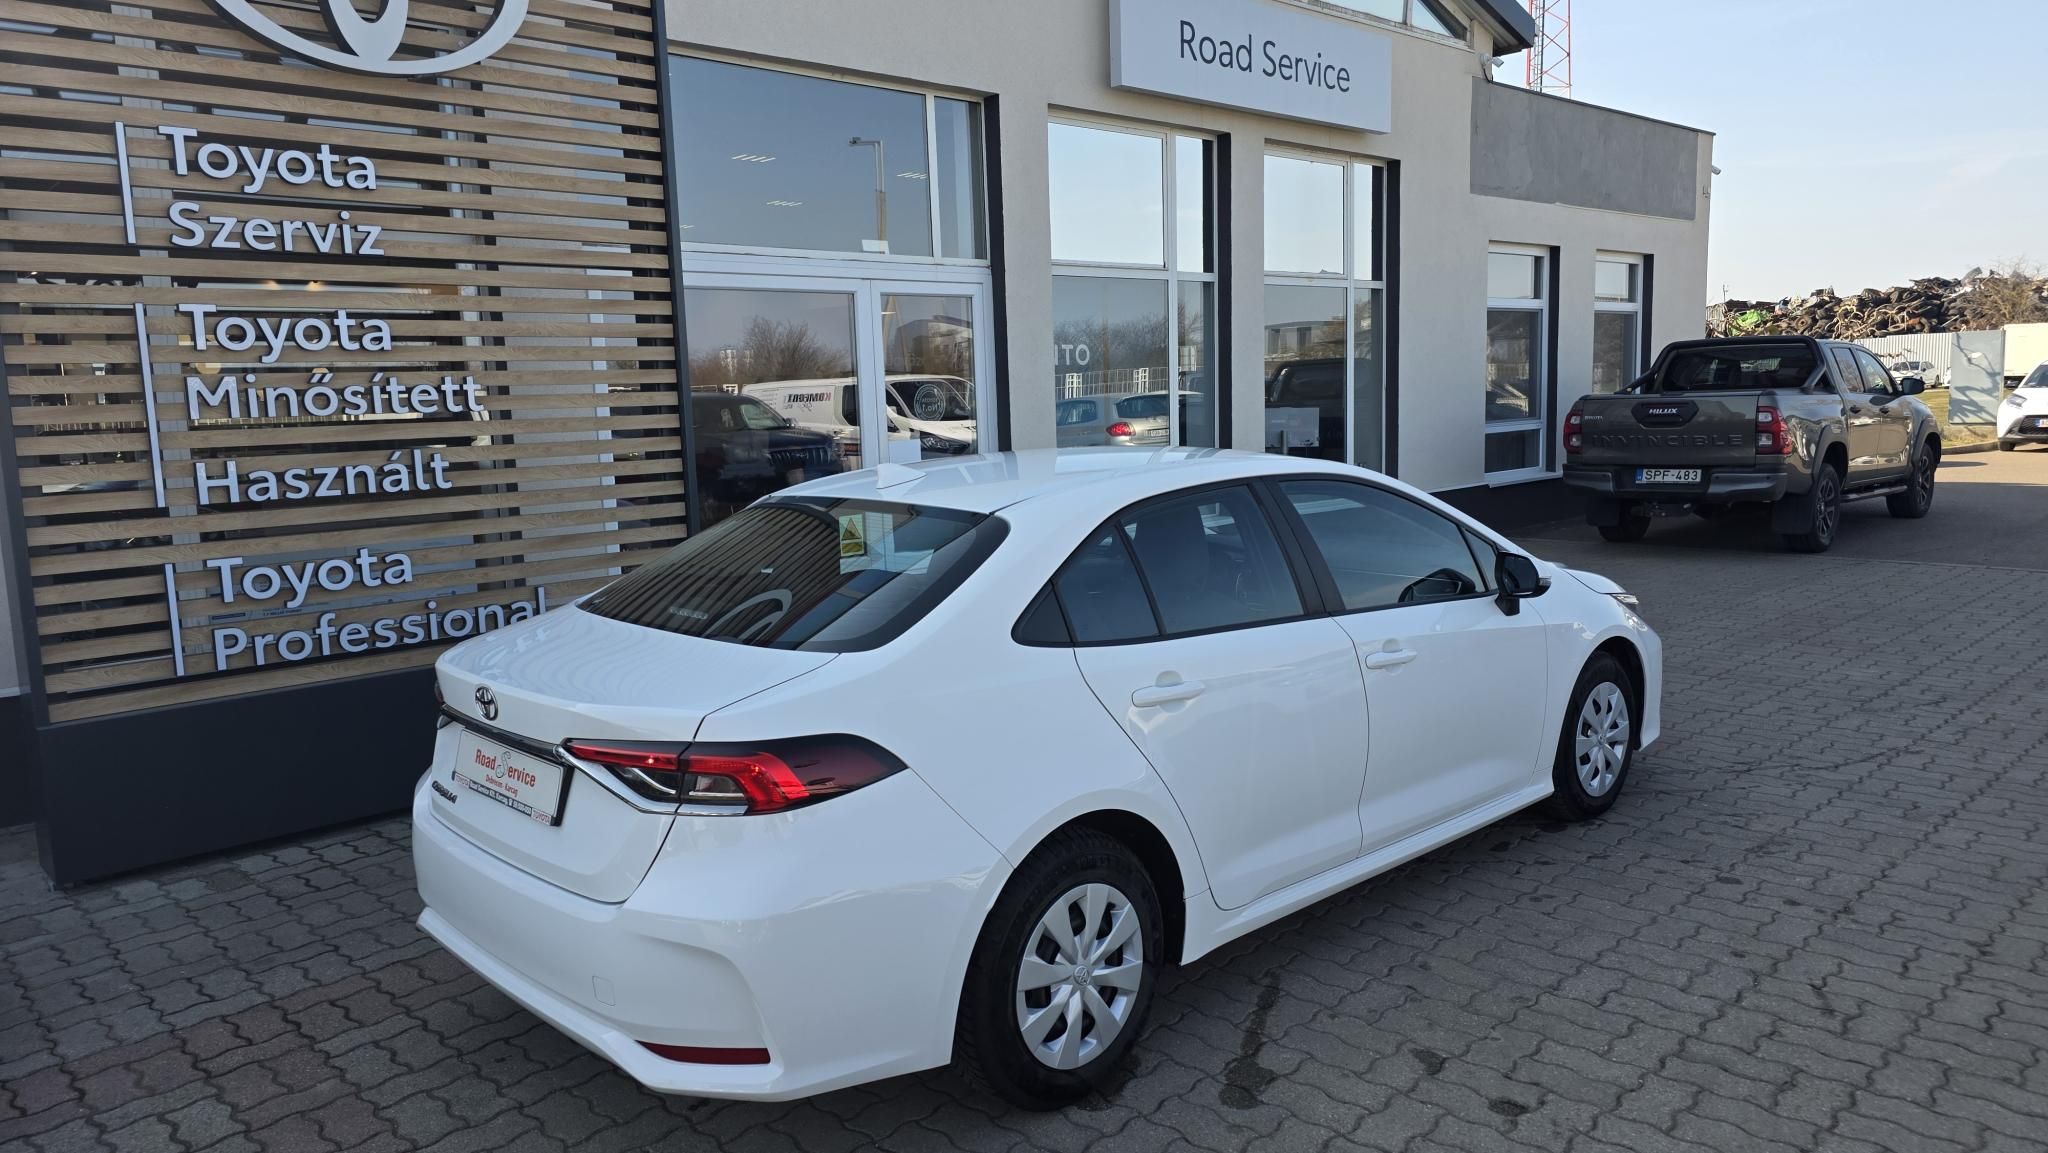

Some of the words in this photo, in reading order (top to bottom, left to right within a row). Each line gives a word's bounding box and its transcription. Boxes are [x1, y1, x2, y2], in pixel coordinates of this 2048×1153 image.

[1179, 19, 1254, 74] Road
[1262, 40, 1351, 93] Service
[158, 125, 378, 194] Toyota
[168, 200, 386, 256] Szerviz
[178, 303, 392, 363] Toyota
[185, 371, 486, 421] Minősített
[1648, 407, 1679, 415] HILUX
[1592, 433, 1744, 448] INVINCIBLE
[194, 448, 453, 507] Használt
[1643, 469, 1699, 481] SPF-483
[206, 547, 413, 608] Toyota
[213, 587, 547, 671] Professional
[475, 748, 496, 770] Road
[495, 751, 536, 788] Service
